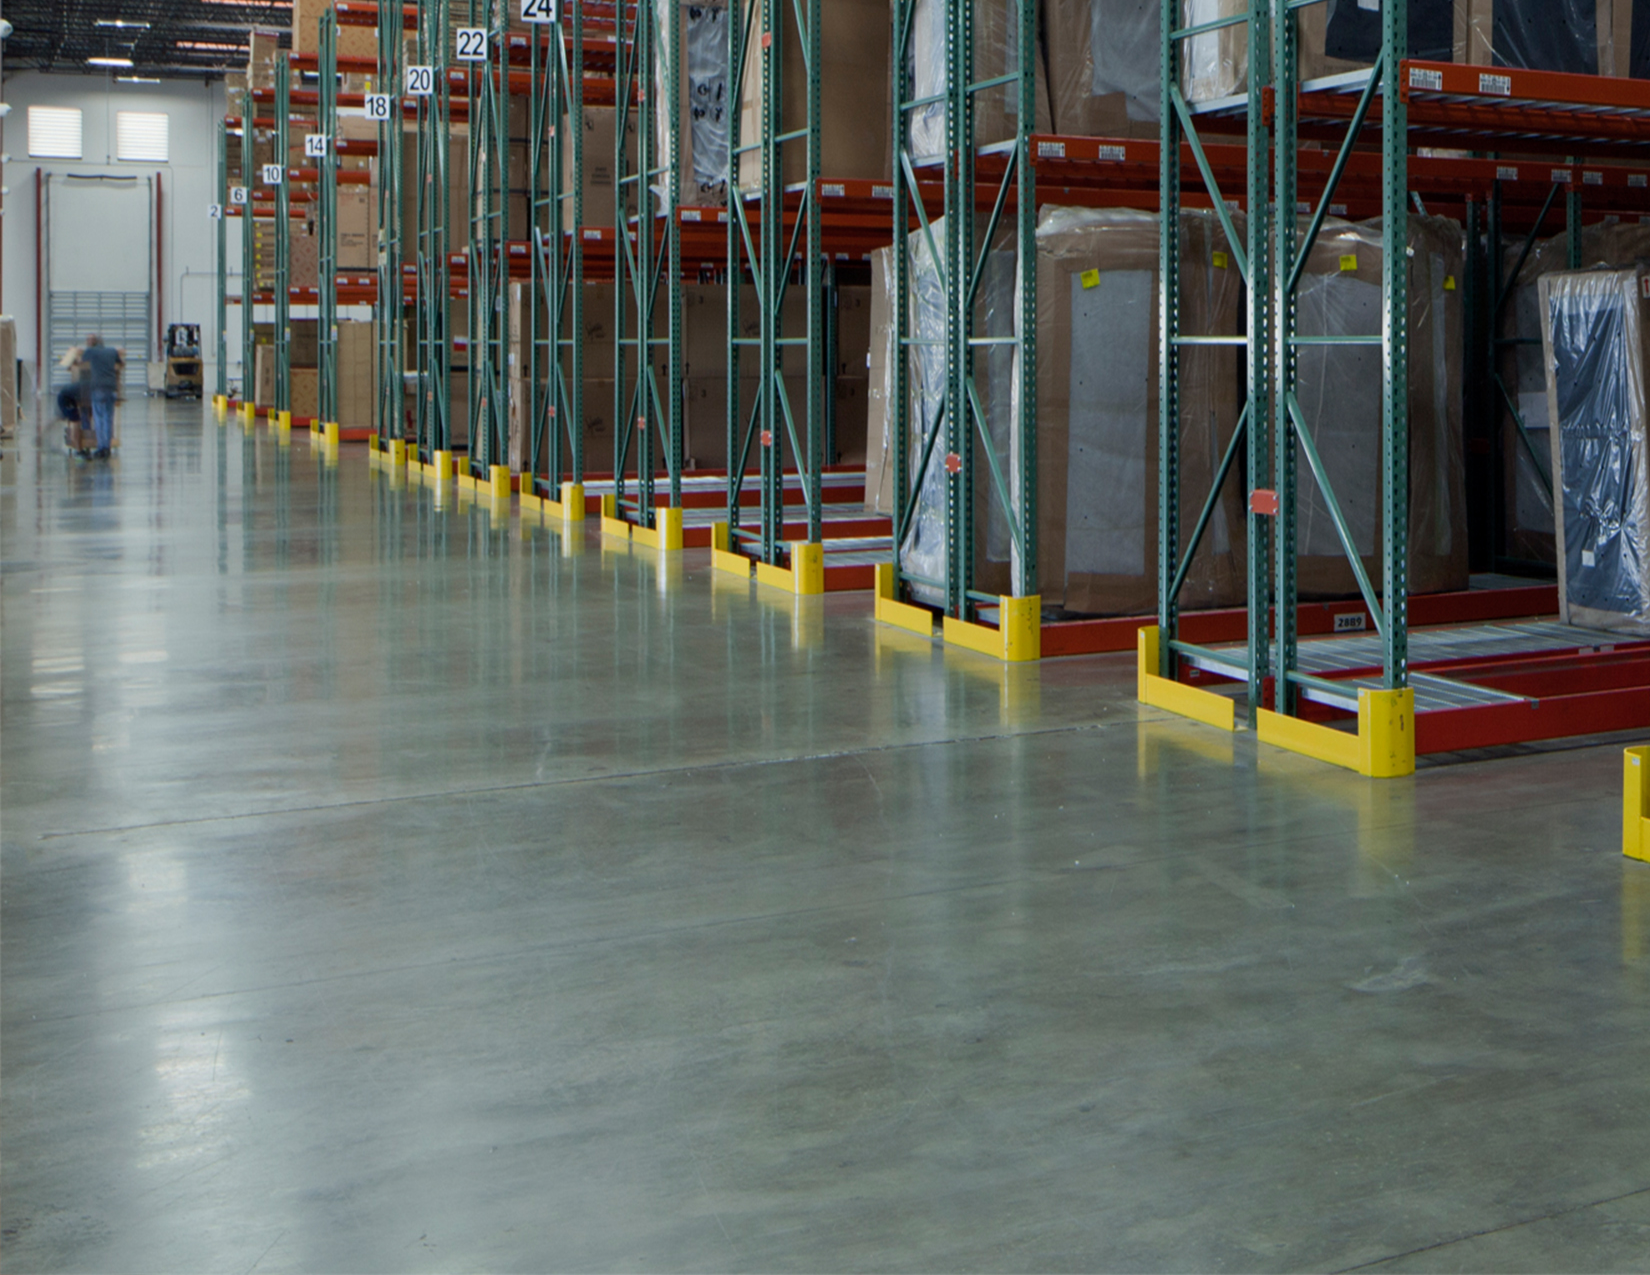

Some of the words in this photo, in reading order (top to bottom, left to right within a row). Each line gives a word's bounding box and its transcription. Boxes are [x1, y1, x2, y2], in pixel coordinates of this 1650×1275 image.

[458, 31, 484, 56] 22
[409, 68, 431, 91] 20
[367, 96, 387, 117] 18
[308, 137, 324, 153] 14
[266, 166, 280, 181] 10
[234, 188, 243, 201] 6
[210, 205, 218, 217] 2
